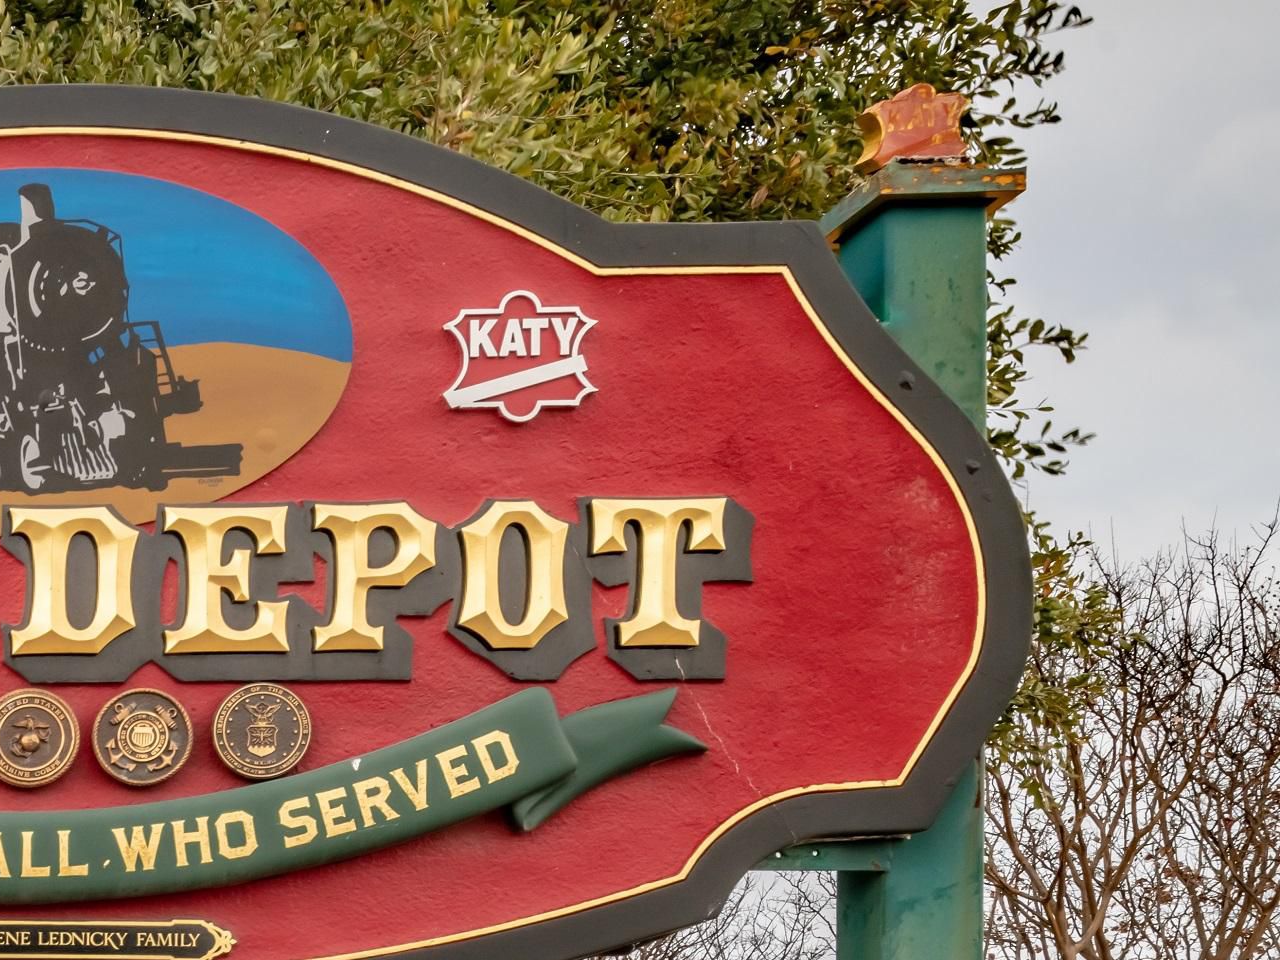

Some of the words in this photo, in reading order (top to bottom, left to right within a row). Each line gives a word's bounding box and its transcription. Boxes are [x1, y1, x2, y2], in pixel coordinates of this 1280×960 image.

[887, 101, 959, 132] KATY
[469, 317, 579, 358] KATY
[10, 497, 728, 655] DEPOT
[34, 698, 65, 720] STATES
[217, 692, 246, 734] DEPARTMENT
[267, 686, 284, 695] THE
[287, 695, 299, 707] AIR
[299, 710, 309, 734] FORCE
[34, 759, 61, 777] CORPS
[112, 810, 259, 873] WHO
[278, 729, 521, 849] SERVED
[38, 931, 128, 950] LEDNICKY
[136, 932, 201, 948] FAMILY
